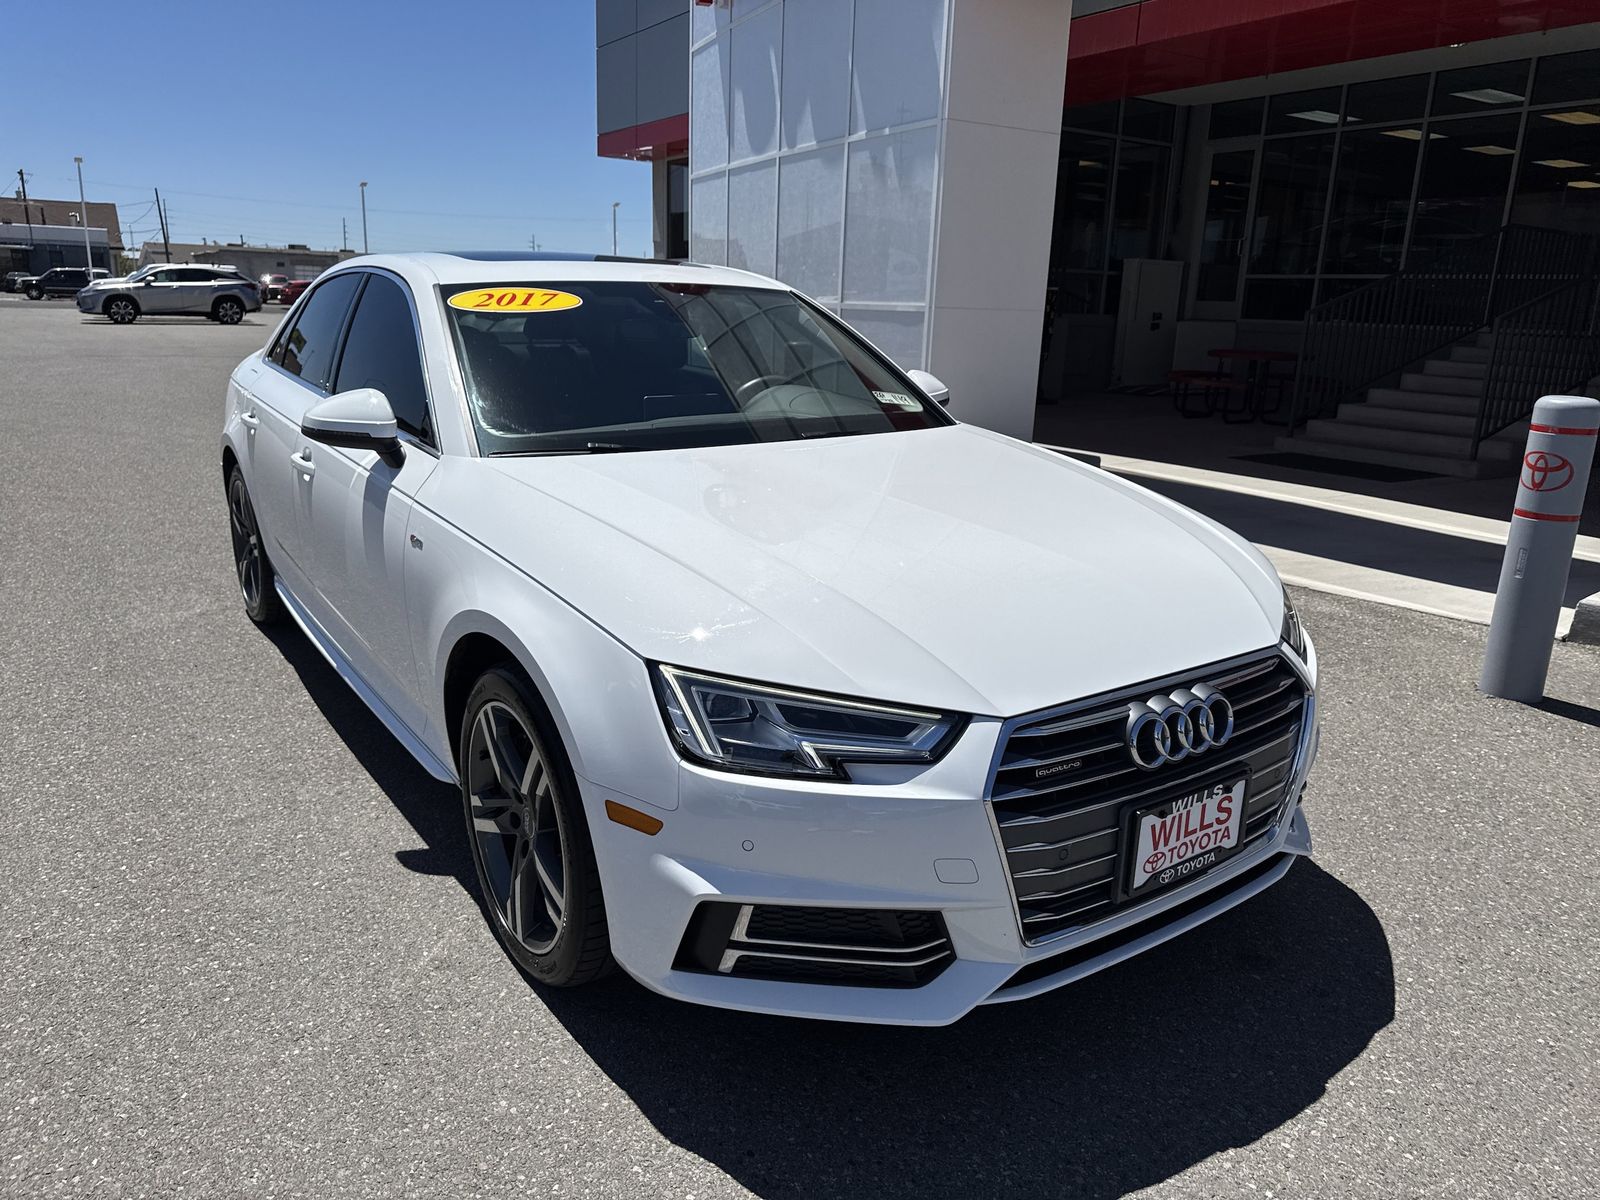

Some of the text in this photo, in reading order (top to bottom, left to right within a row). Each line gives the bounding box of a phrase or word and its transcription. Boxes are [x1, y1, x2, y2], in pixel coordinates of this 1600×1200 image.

[473, 293, 559, 308] 2017
[1038, 761, 1081, 777] quattro
[1172, 784, 1224, 814] WILLS
[1151, 795, 1233, 851] WILLS
[1168, 826, 1231, 863] TOYOTA
[1177, 852, 1216, 876] TOYOTA
